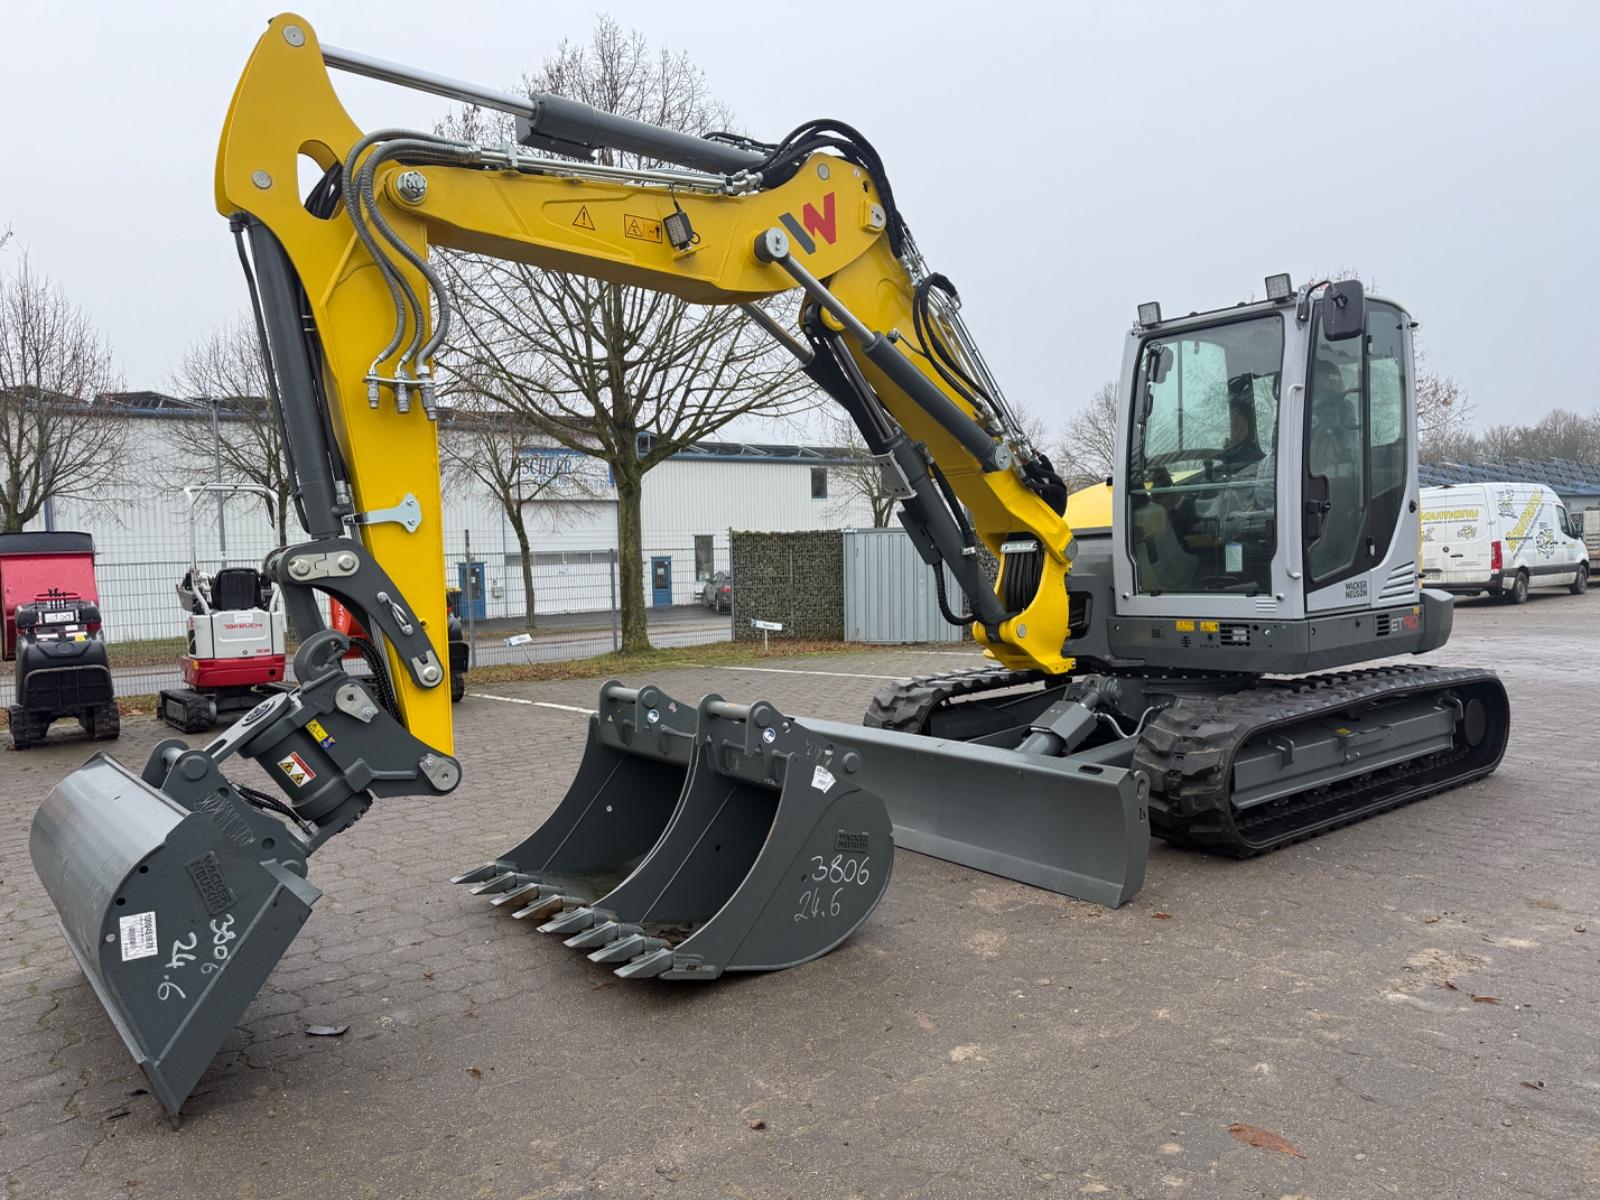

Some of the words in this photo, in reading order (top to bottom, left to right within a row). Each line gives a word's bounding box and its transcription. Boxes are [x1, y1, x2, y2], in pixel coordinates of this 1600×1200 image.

[1345, 580, 1368, 590] WACKER
[1345, 588, 1368, 599] NEUSON
[223, 622, 263, 630] TAKEUCHI
[1391, 614, 1419, 632] ET90
[201, 853, 233, 904] WACKER
[811, 854, 870, 885] 3806
[190, 859, 223, 914] NEUSON
[794, 887, 844, 922] 24.6
